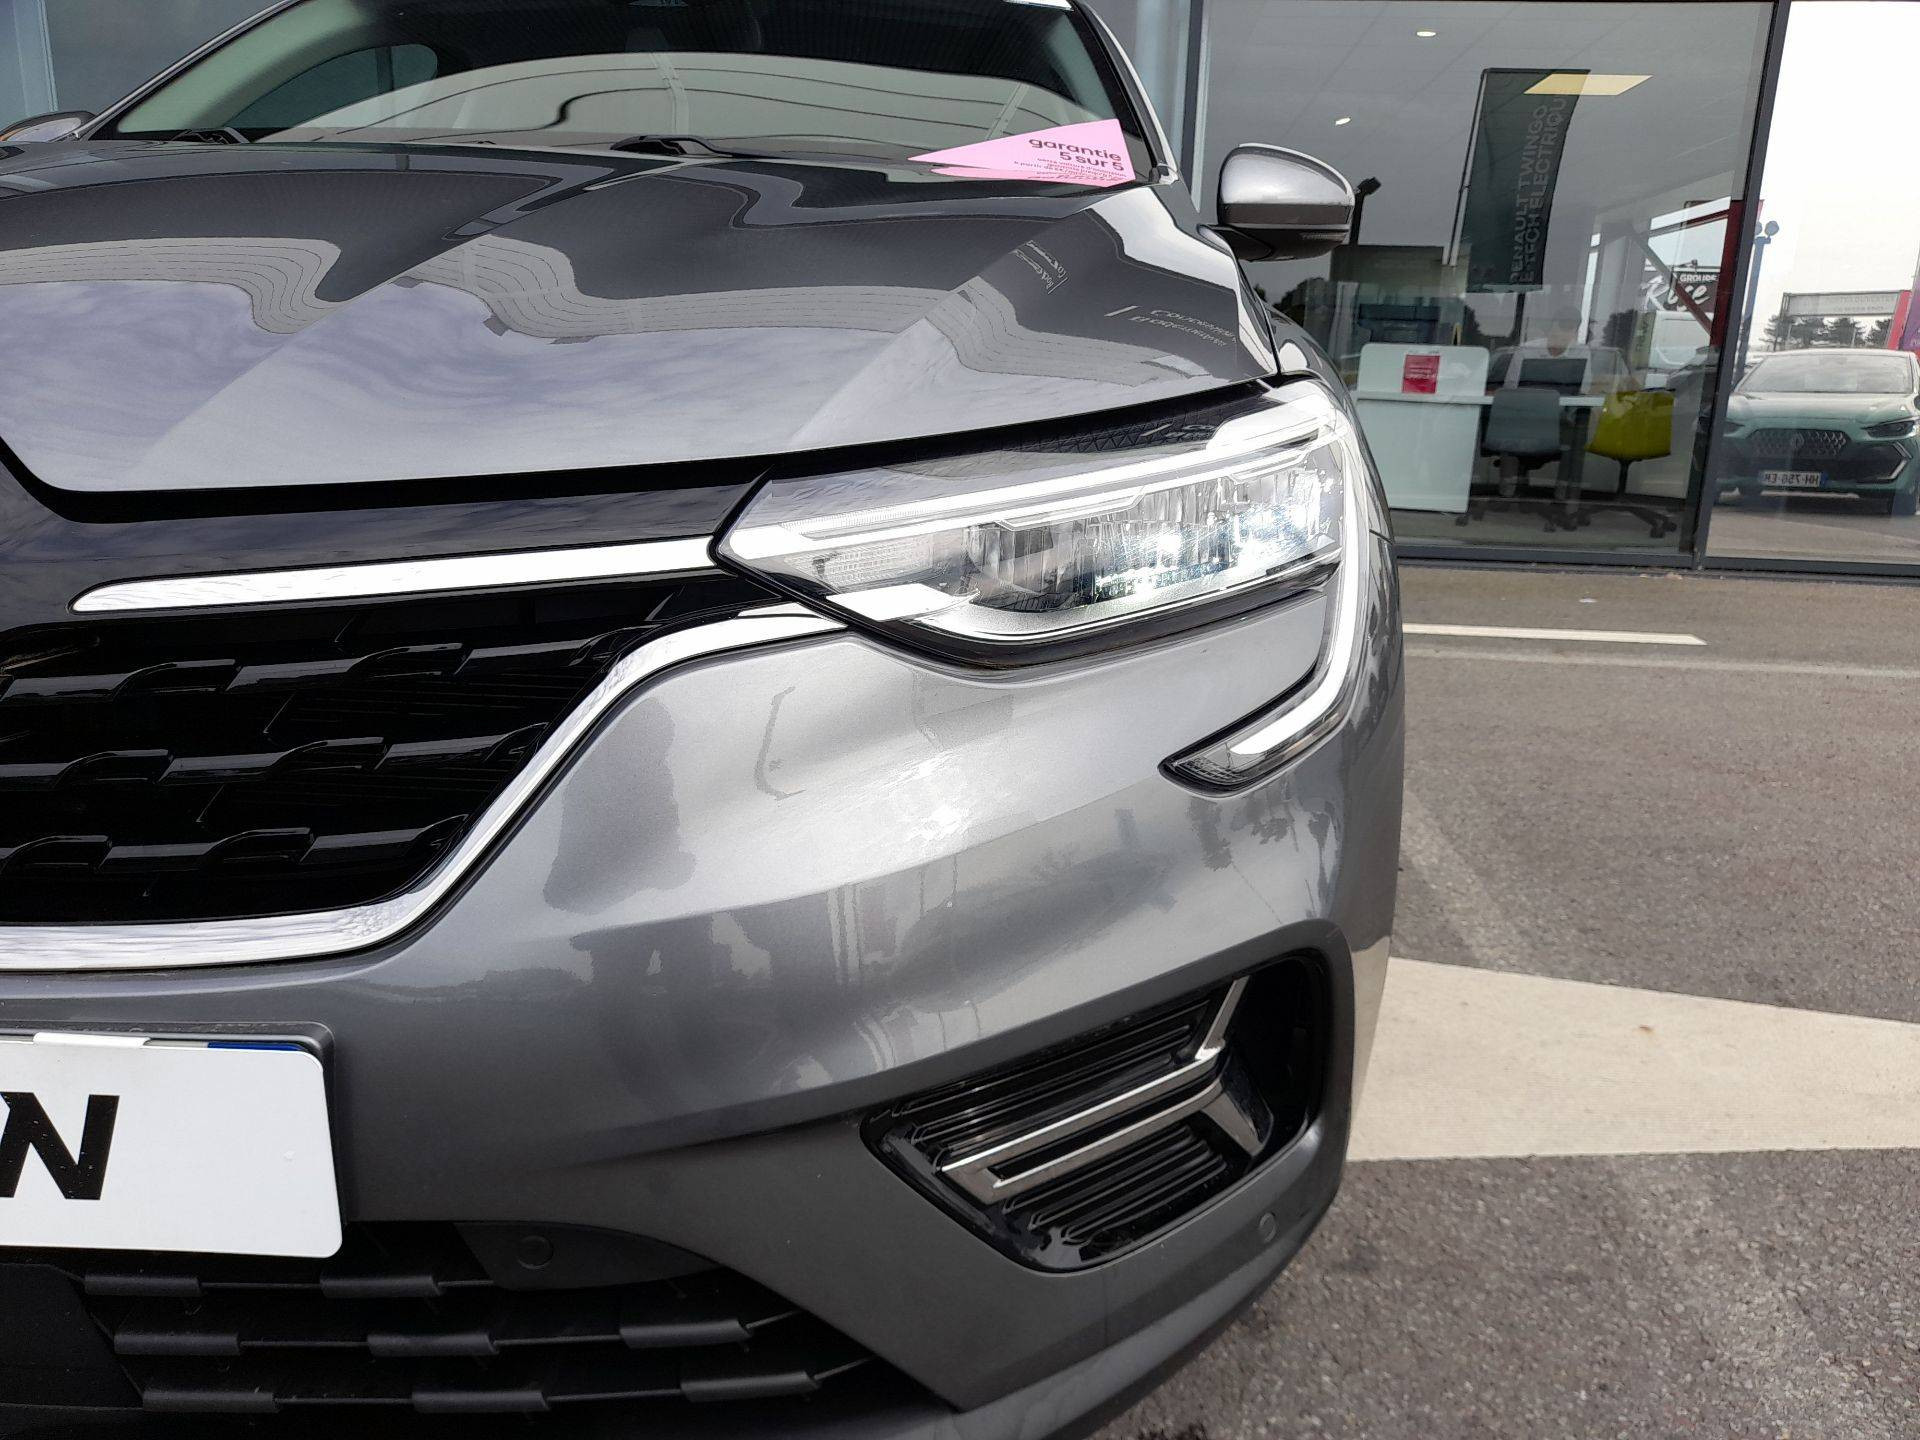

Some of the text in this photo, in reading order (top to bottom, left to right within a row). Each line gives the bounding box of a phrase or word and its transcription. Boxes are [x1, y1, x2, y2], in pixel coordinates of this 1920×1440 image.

[1028, 138, 1121, 161] garantie
[1060, 151, 1072, 161] 5
[1076, 155, 1108, 168] sur
[1113, 162, 1125, 172] 5
[1518, 105, 1548, 189] TWINGO
[1529, 98, 1567, 208] ELECTRIQU
